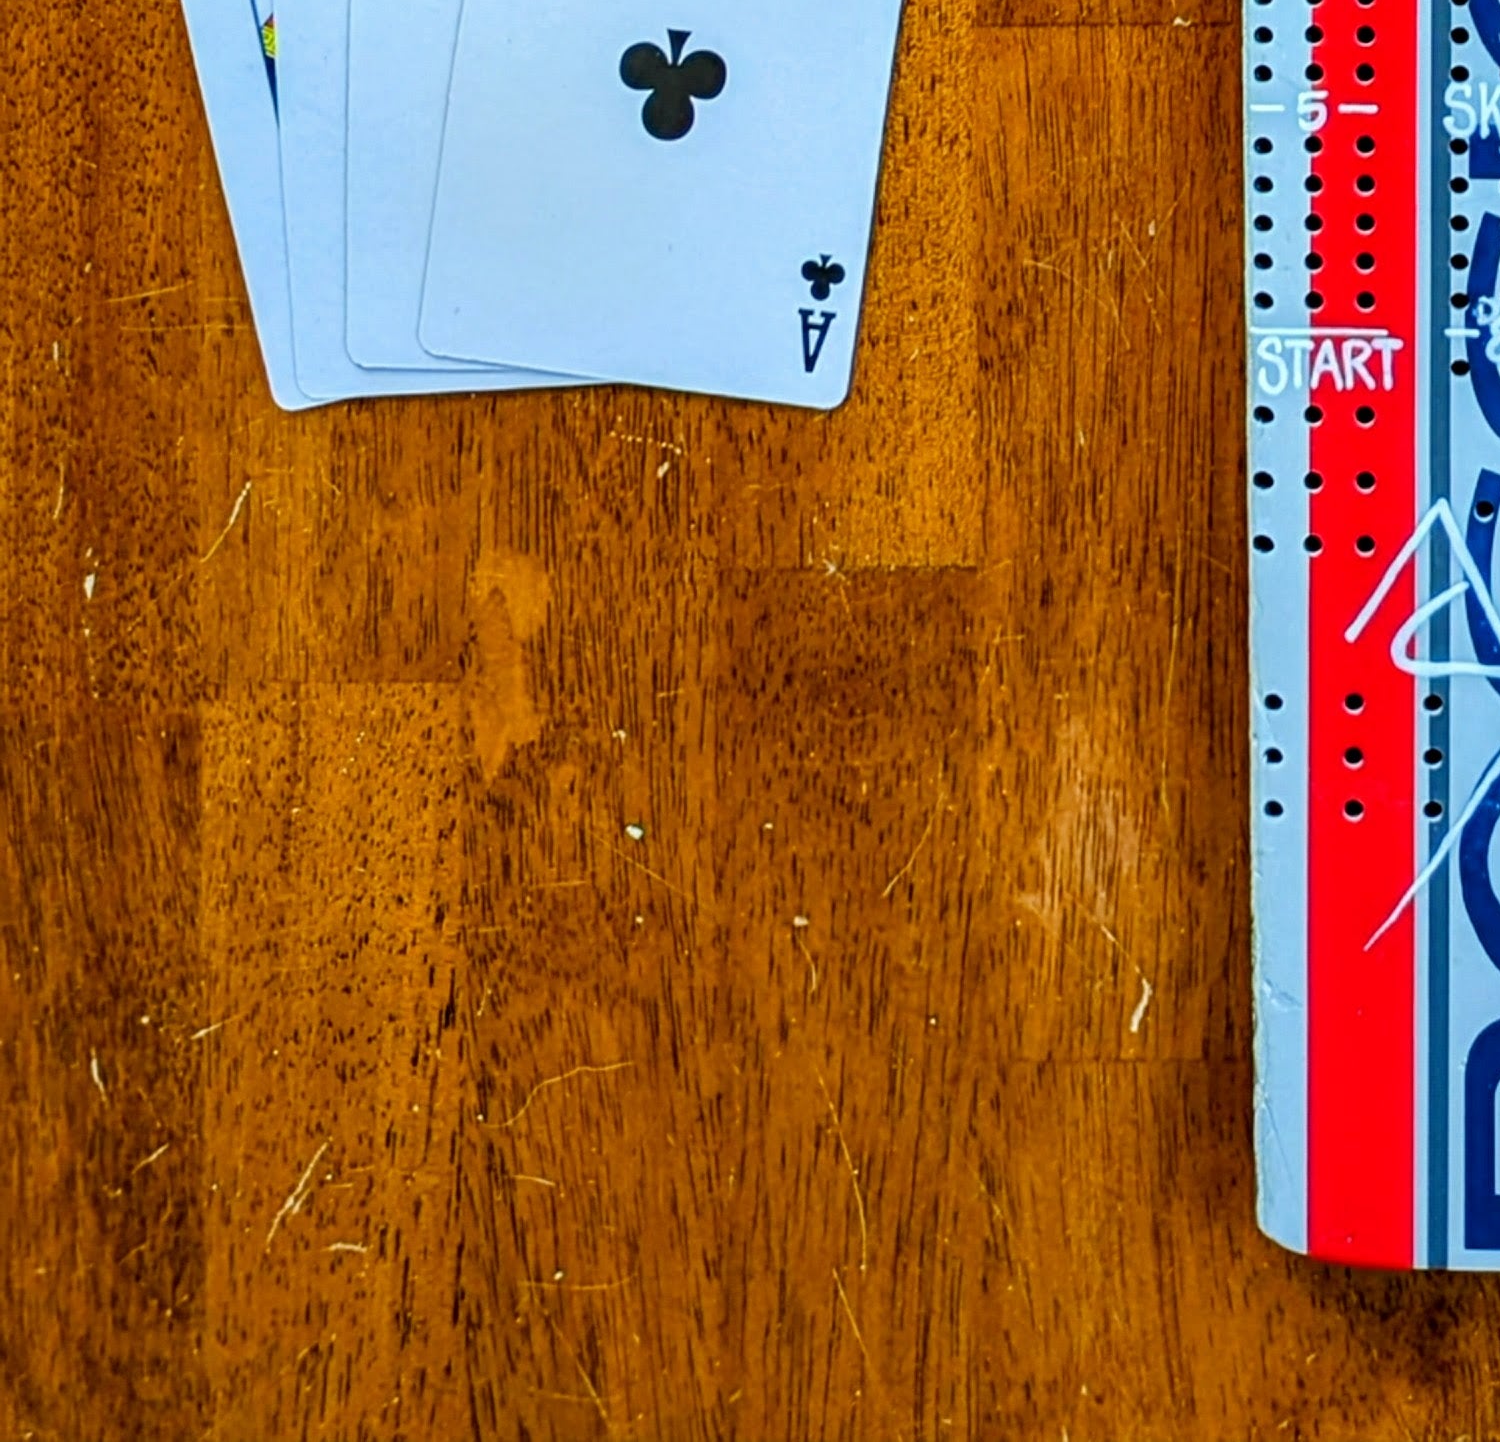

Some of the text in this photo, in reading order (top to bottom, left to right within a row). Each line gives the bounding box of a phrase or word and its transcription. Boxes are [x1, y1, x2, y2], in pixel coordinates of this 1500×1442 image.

[1298, 91, 1330, 131] 5
[798, 309, 836, 373] A
[1257, 336, 1404, 394] START
